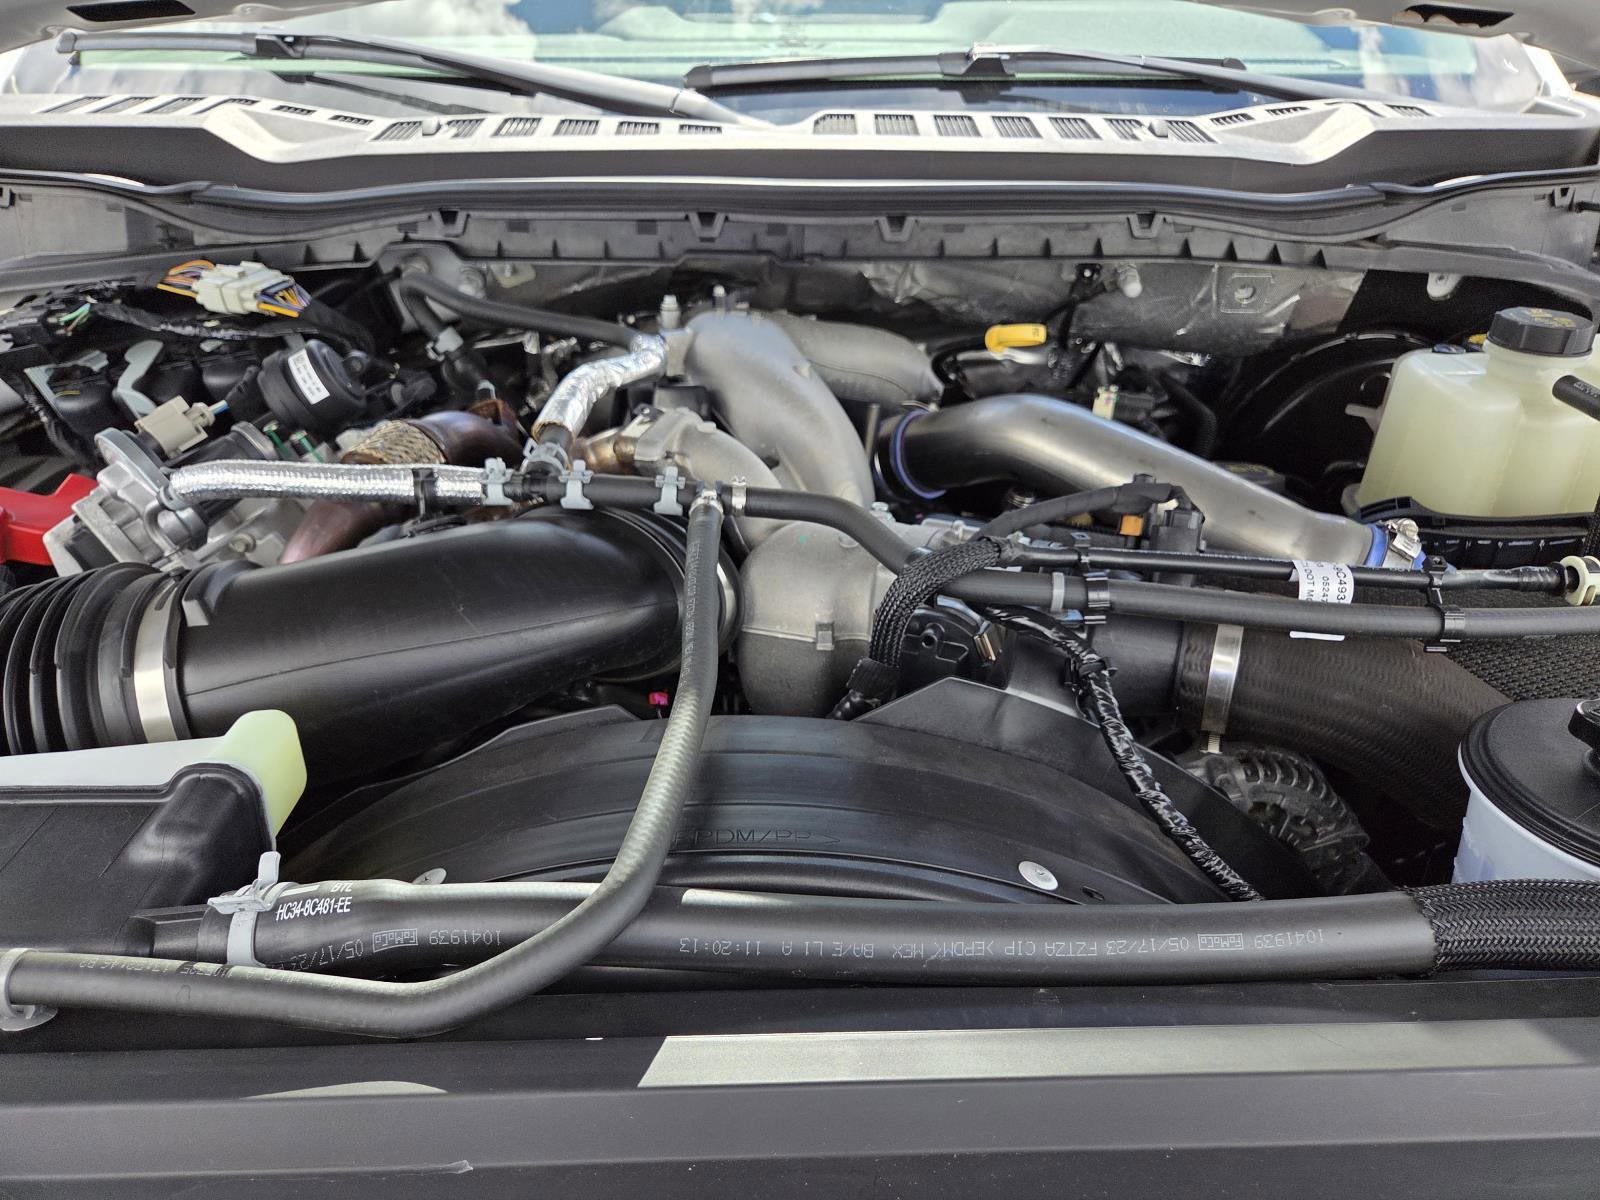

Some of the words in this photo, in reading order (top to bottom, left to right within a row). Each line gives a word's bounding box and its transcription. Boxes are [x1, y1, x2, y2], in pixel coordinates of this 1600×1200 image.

[275, 897, 352, 921] HC34-8C481-EE
[373, 929, 418, 949] FoMoCo
[429, 929, 501, 946] 1041939
[1106, 937, 1189, 955] 05/17/23
[1199, 934, 1243, 949] FoMoCo
[1254, 929, 1324, 949] 1041939
[679, 937, 761, 956] 11:20:13
[781, 940, 793, 956] A
[892, 943, 924, 958] MEX
[1004, 941, 1036, 956] CIP
